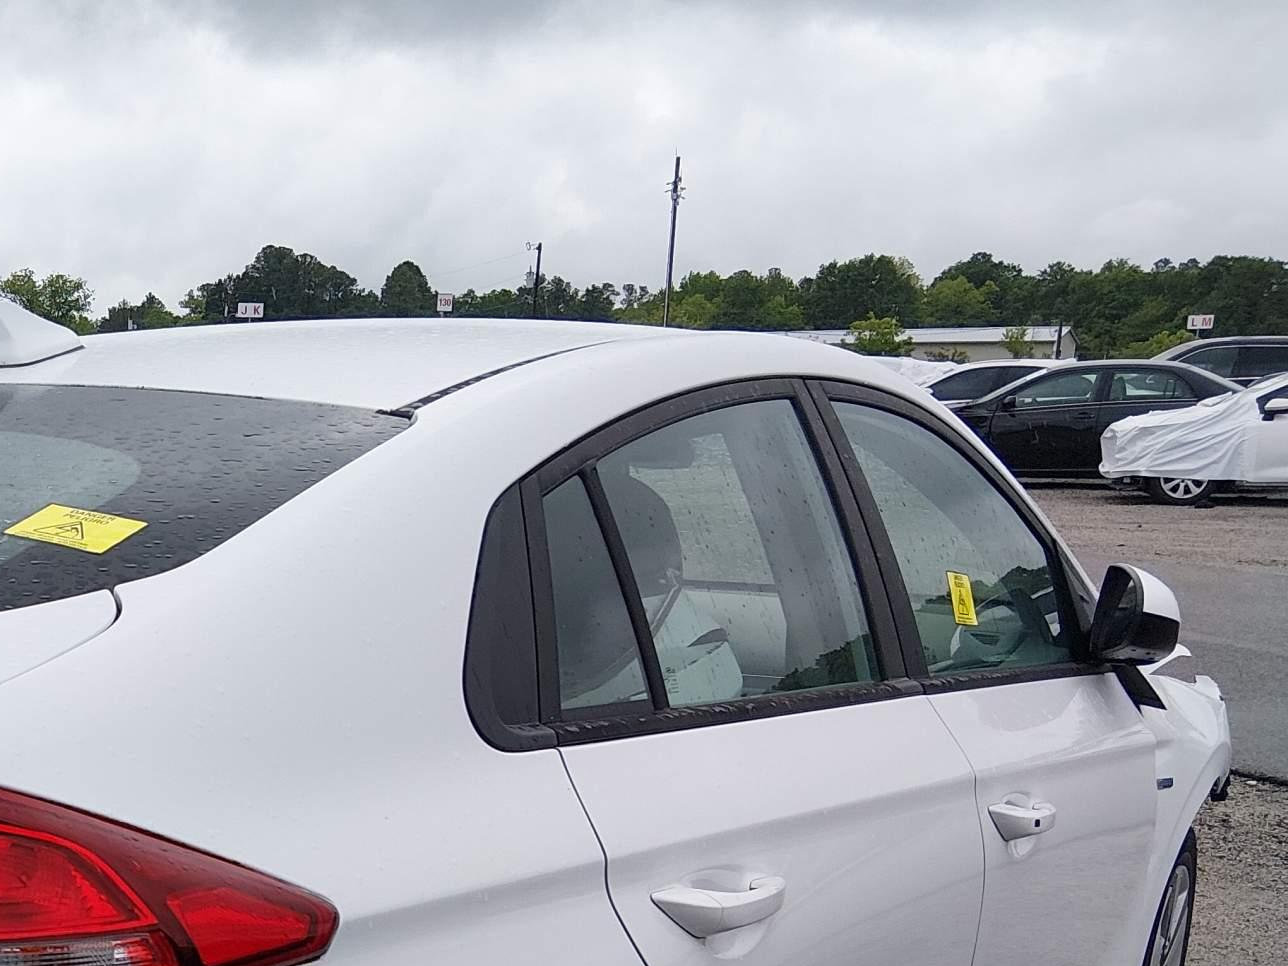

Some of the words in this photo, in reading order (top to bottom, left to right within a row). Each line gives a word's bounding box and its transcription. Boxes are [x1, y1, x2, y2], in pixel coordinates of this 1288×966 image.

[241, 305, 248, 315] J
[253, 304, 261, 315] K
[1192, 317, 1198, 327] L
[1201, 317, 1212, 327] M
